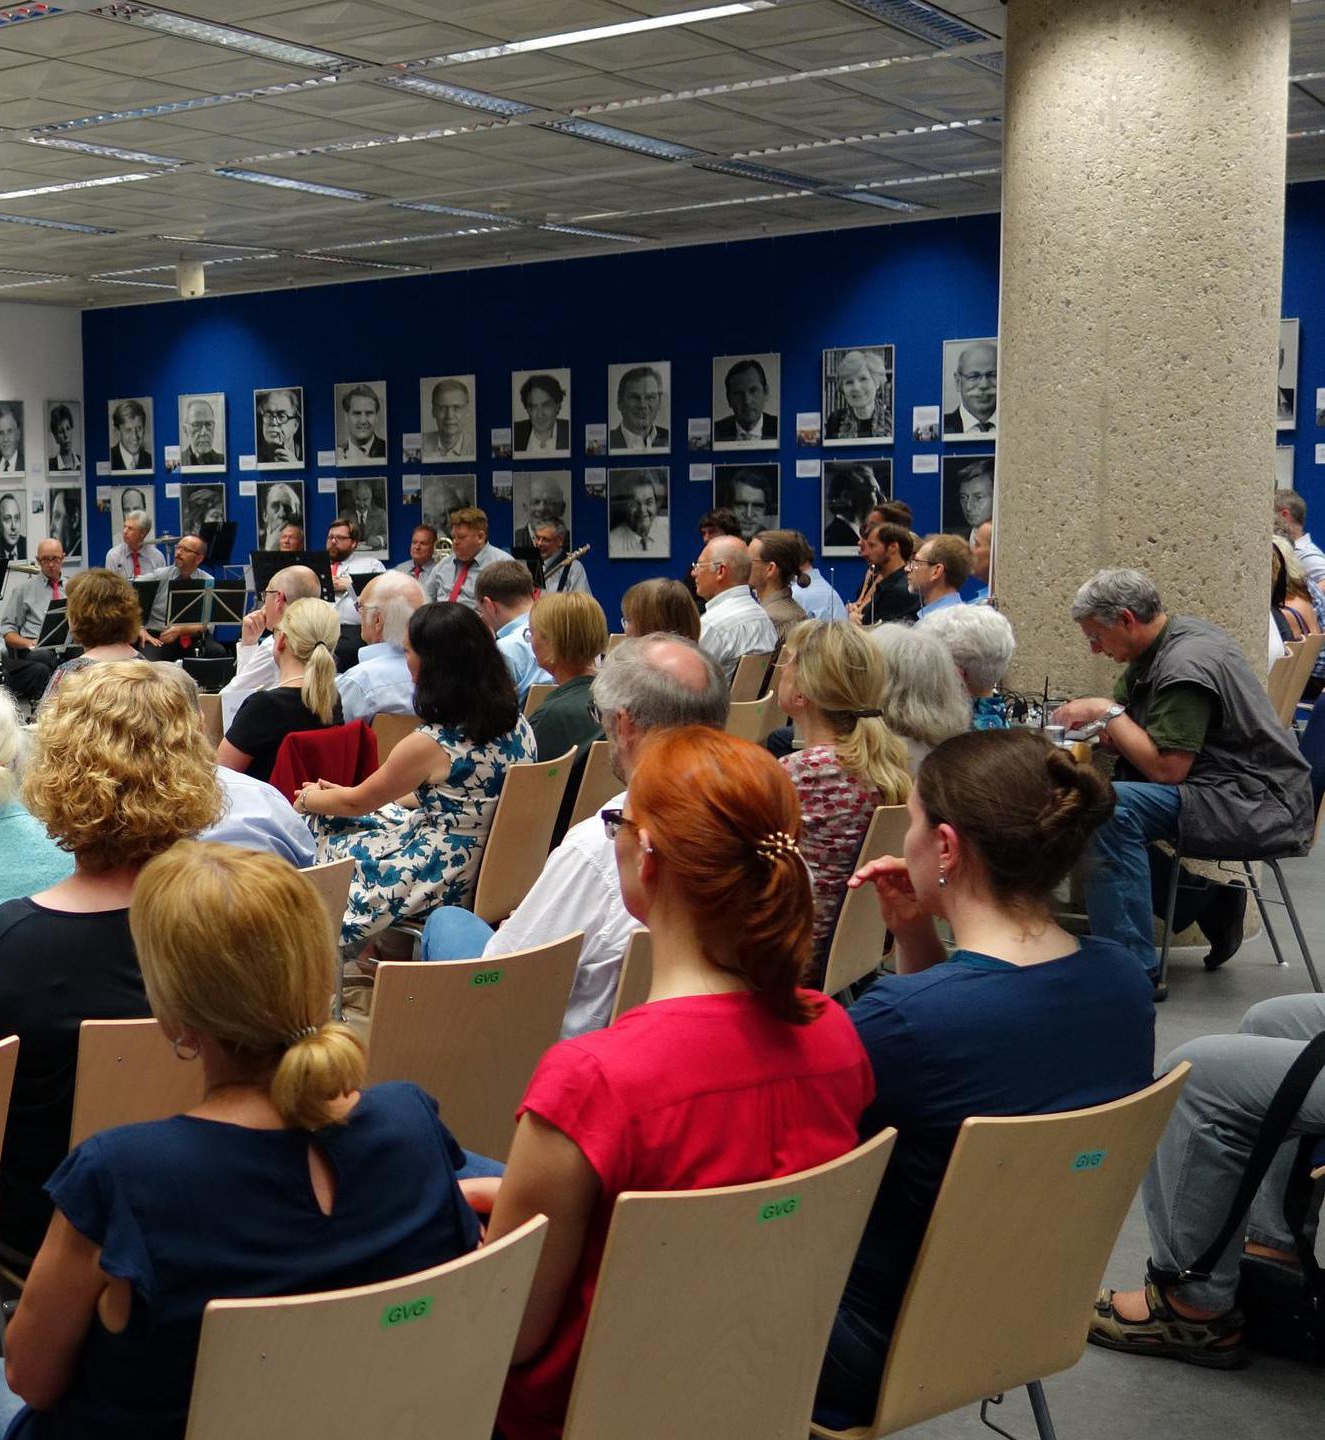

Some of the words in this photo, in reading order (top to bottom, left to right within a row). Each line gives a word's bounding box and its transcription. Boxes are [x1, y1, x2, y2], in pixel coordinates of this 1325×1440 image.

[474, 971, 500, 985] GVG
[762, 1199, 796, 1219] GVG
[387, 1301, 427, 1323] GVG
